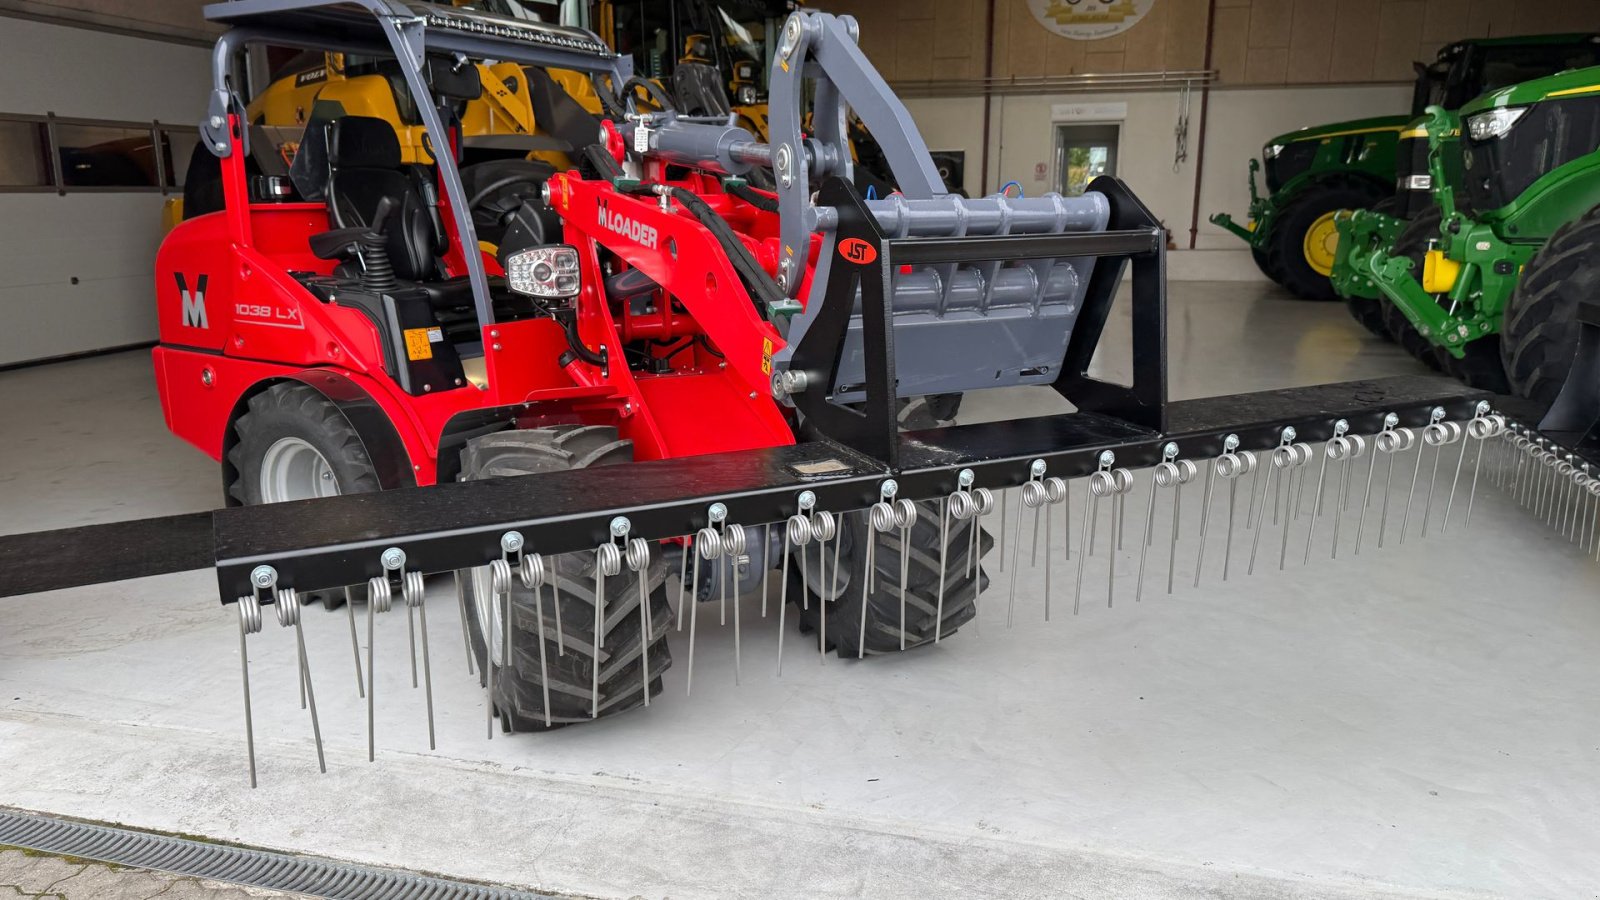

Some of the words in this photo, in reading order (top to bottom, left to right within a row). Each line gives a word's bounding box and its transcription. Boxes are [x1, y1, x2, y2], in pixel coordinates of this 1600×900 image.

[300, 69, 327, 82] VOLV
[847, 242, 867, 261] JST
[235, 303, 271, 317] 1038
[276, 308, 297, 320] LX
